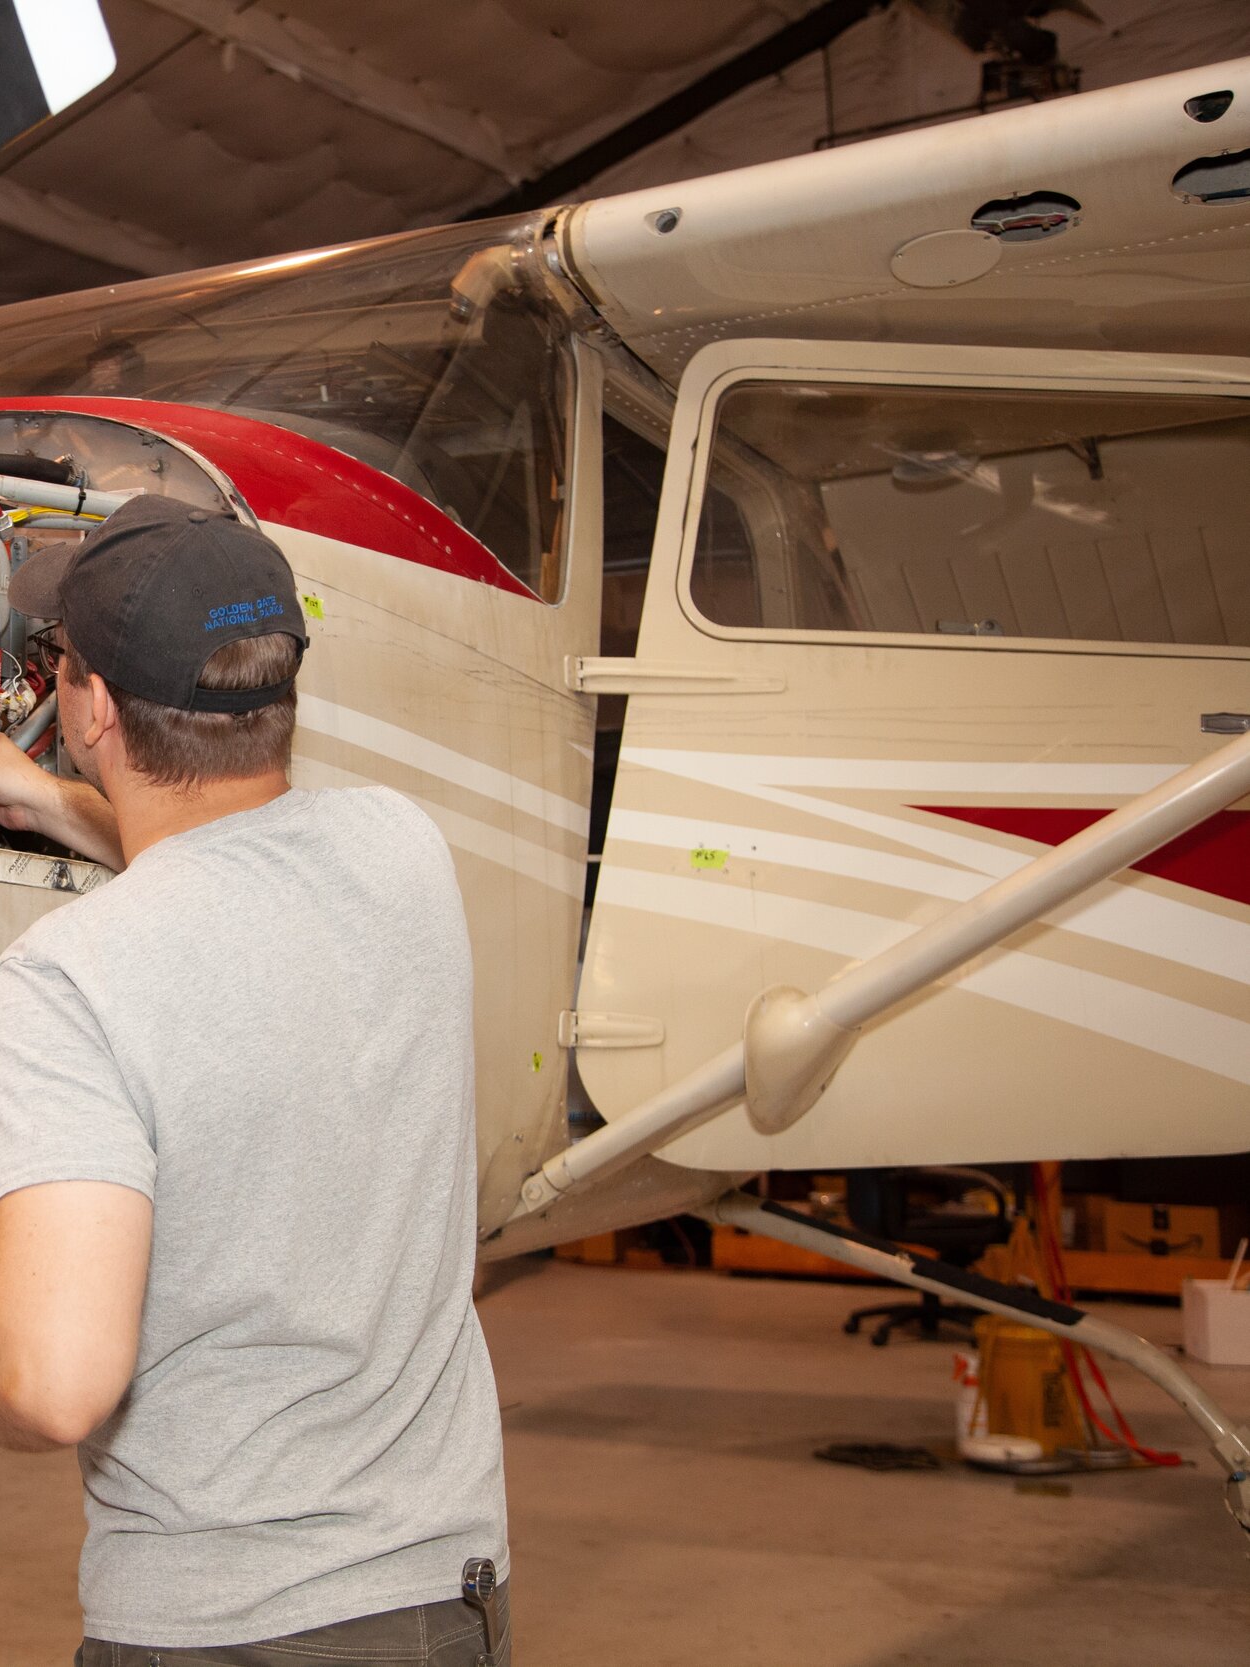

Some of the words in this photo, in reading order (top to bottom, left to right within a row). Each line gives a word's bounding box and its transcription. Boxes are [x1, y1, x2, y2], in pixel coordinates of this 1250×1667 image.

[205, 614, 258, 632] NATIONAL
[259, 604, 284, 617] PARKS
[209, 602, 254, 619] GOLDEN
[257, 595, 276, 609] GATE
